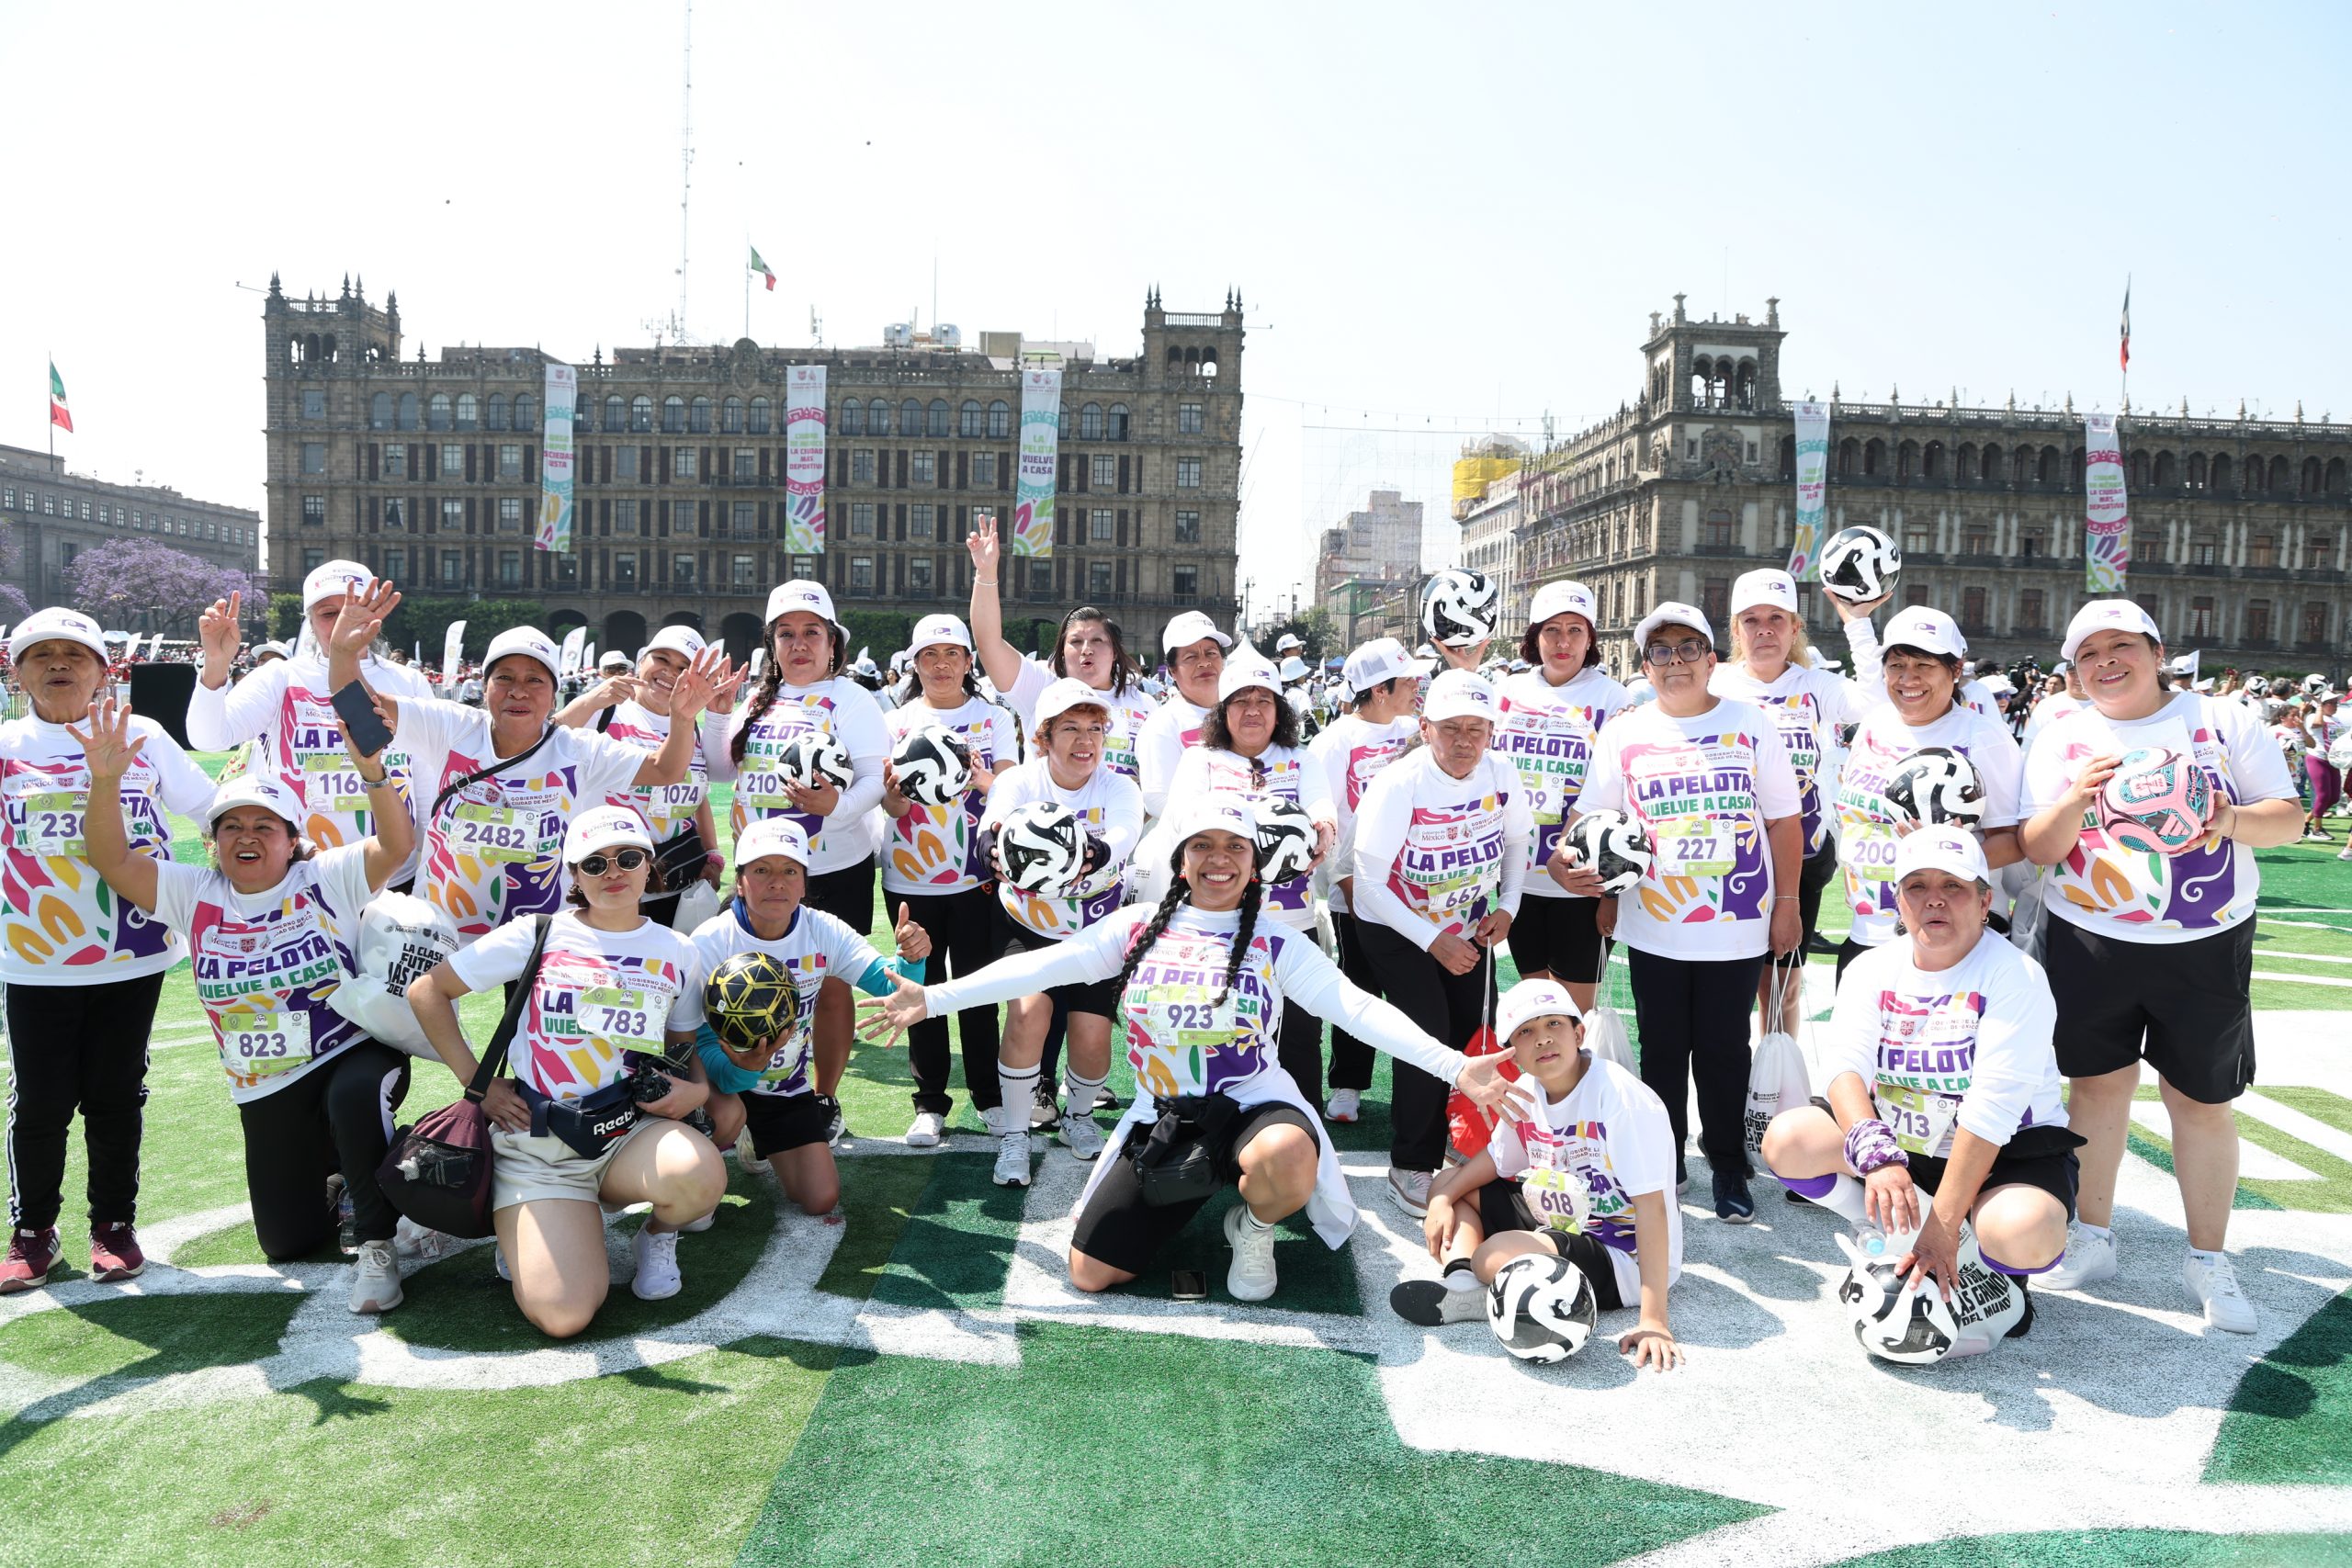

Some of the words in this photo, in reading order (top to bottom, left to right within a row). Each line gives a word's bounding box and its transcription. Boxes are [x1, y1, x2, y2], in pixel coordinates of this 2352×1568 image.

[1023, 445, 1054, 453] PELOTA
[1034, 434, 1045, 443] LA
[1023, 455, 1054, 464] VUELVE
[1030, 466, 1052, 475] CASA
[294, 729, 321, 748] LA
[764, 743, 773, 756] A
[1491, 734, 1508, 750] LA
[1512, 736, 1586, 760] PELOTA
[1105, 751, 1113, 762] A
[1533, 759, 1544, 772] A
[1546, 761, 1583, 775] CASA
[1791, 753, 1815, 766] ASA
[662, 784, 699, 805] 1074
[1637, 779, 1665, 802] LA
[1669, 773, 1752, 796] PELOTA
[2189, 770, 2198, 802] TRIONDA
[1643, 799, 1700, 818] VUELVE
[1703, 796, 1715, 811] A
[1718, 795, 1752, 810] CASA
[1869, 799, 1880, 814] A
[41, 813, 85, 838] 23
[463, 822, 526, 850] 2482
[1421, 833, 1445, 841] México
[1407, 850, 1435, 872] LA
[1442, 835, 1504, 870] PELOT
[1677, 838, 1717, 860] 227
[1445, 885, 1482, 908] 667
[198, 956, 220, 979] LA
[227, 935, 332, 978] PELOTA
[402, 942, 416, 954] LA
[417, 946, 445, 963] CLASE
[270, 975, 285, 989] A
[288, 956, 339, 986] CASA
[628, 977, 660, 986] GOBIERNO
[1130, 964, 1157, 986] LA
[386, 984, 404, 998] DEL
[543, 990, 573, 1014] LA
[602, 1008, 647, 1036] 783
[1168, 1004, 1214, 1030] 923
[239, 1032, 287, 1057] 823
[1927, 1077, 1941, 1091] A
[594, 1106, 636, 1135] Reeb
[1891, 1105, 1930, 1139] 713
[1541, 1190, 1574, 1215] 618
[1970, 1261, 1977, 1269] DE
[1962, 1312, 1983, 1326] DEL
